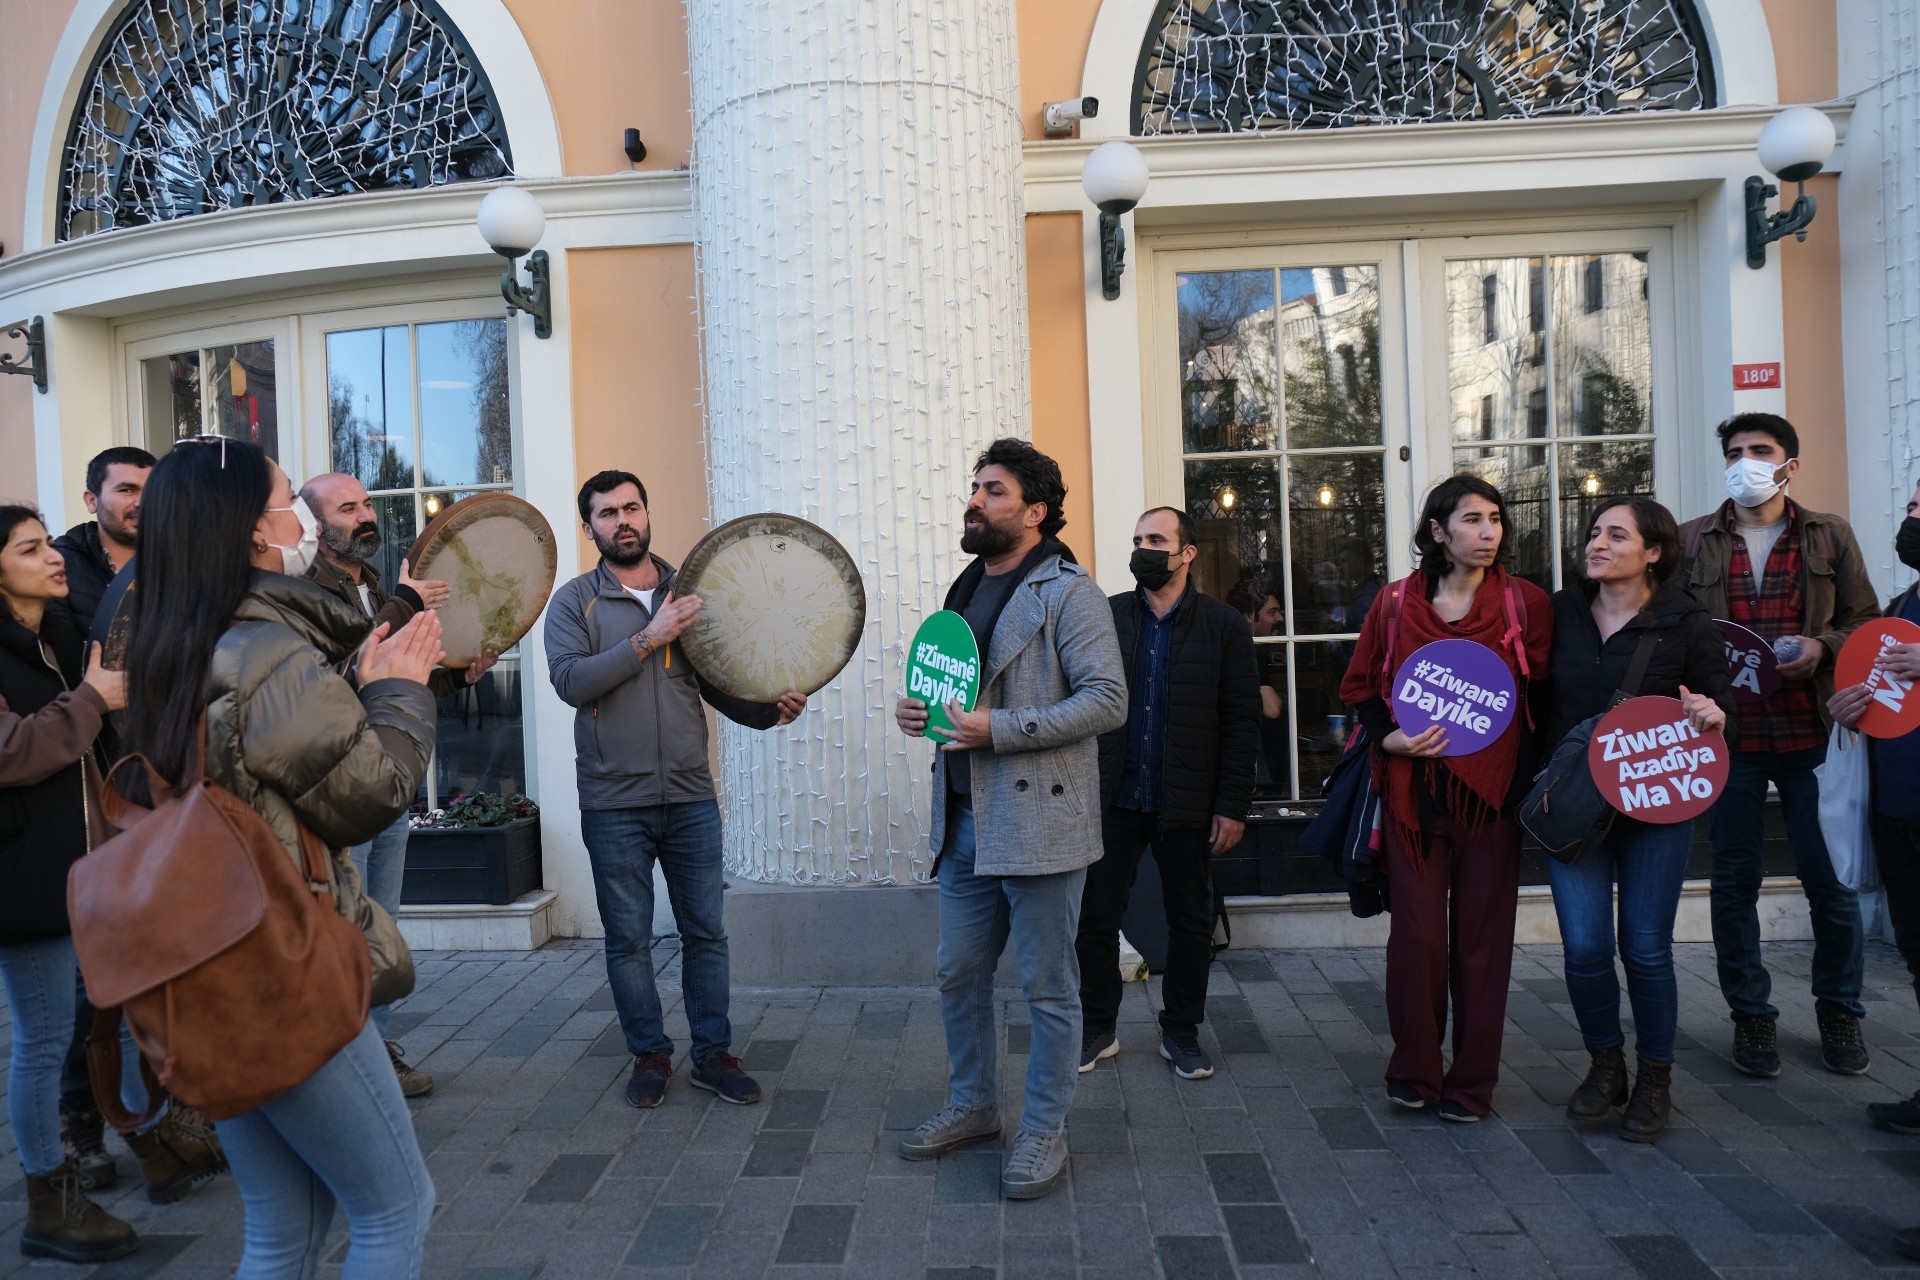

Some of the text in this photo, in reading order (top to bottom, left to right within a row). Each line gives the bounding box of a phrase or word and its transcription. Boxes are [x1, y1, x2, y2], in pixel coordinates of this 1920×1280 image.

[916, 641, 977, 683] #Zimanê
[910, 665, 968, 707] Dayikê
[1398, 678, 1492, 735] Dayike
[1413, 659, 1510, 712] #Ziwanê
[1597, 718, 1700, 762] Ziwan
[1619, 745, 1717, 783] Azadîya
[1619, 773, 1713, 812] Ma Yo
